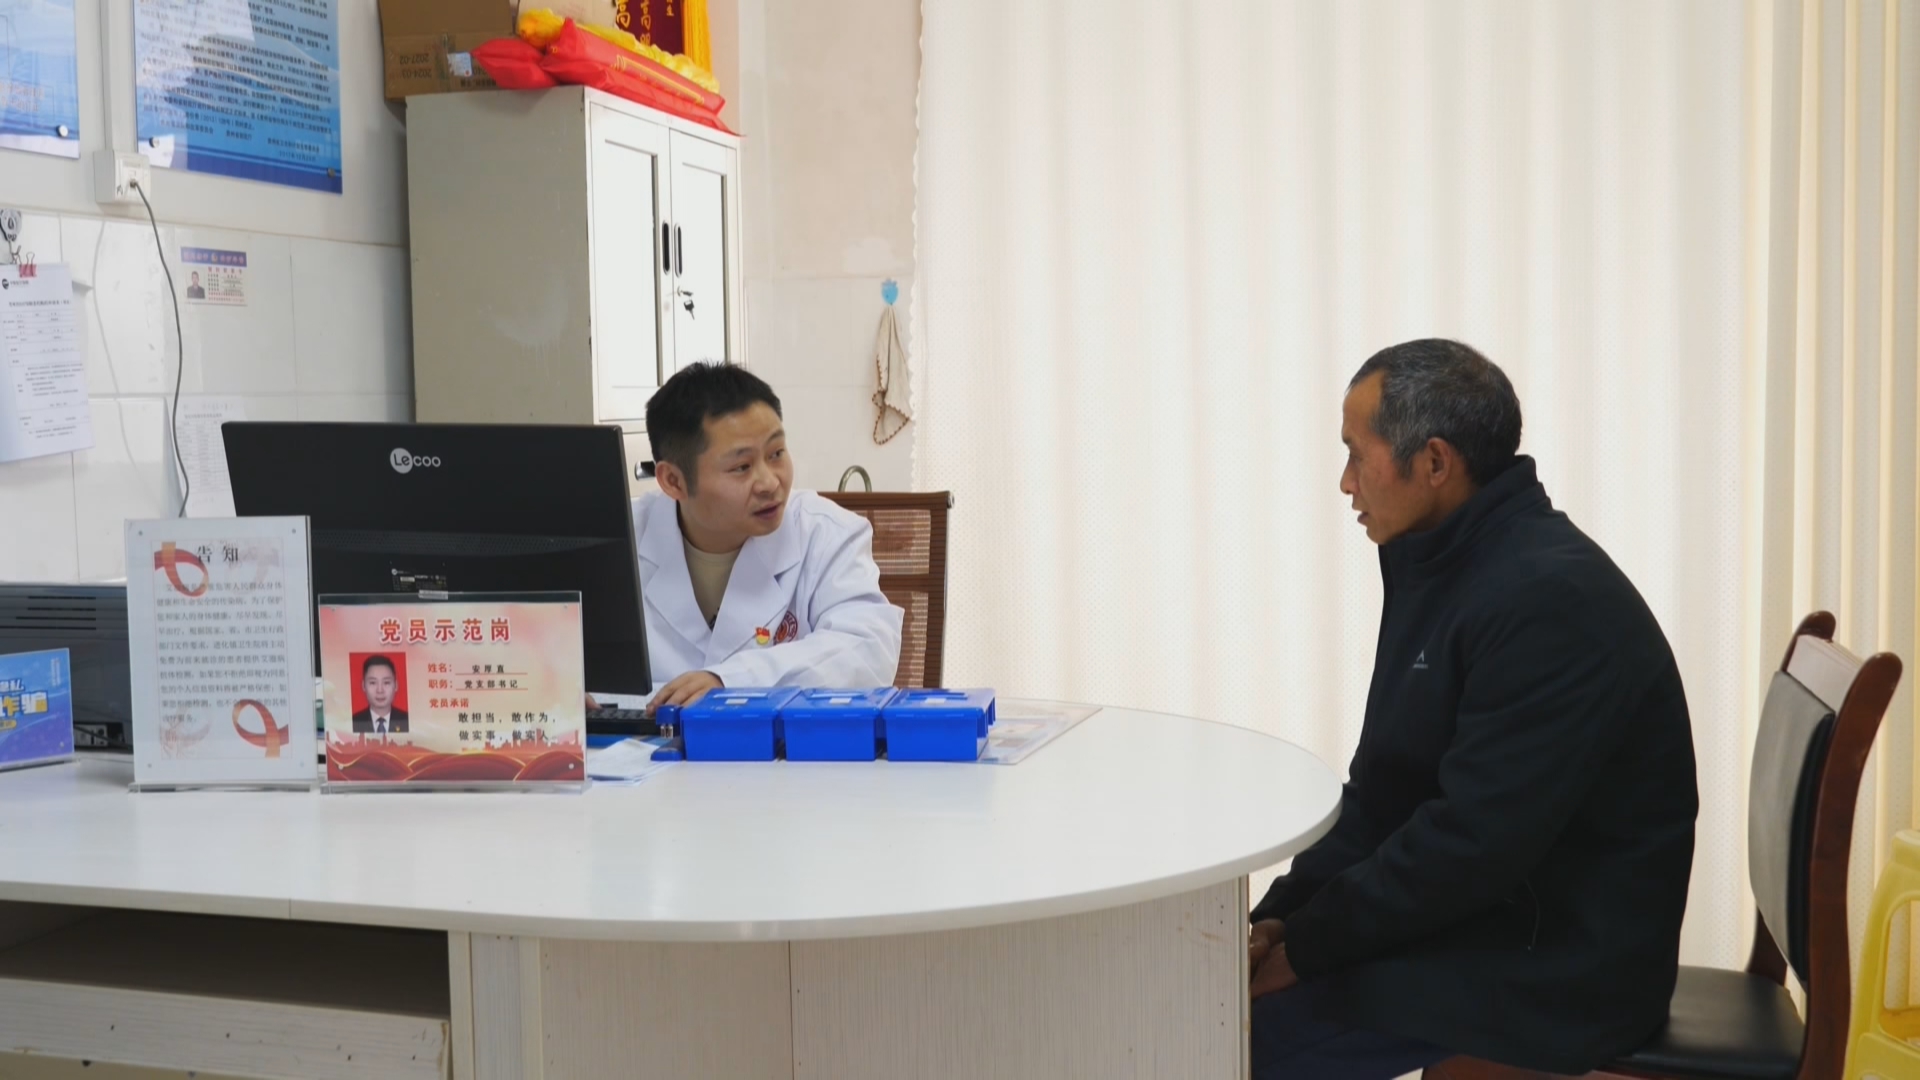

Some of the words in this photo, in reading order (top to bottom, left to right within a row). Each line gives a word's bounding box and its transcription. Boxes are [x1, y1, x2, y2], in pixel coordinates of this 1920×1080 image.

[390, 448, 441, 474] Lecoo
[197, 545, 240, 563] 告知
[380, 617, 509, 642] 党员示范岗
[464, 680, 518, 689] 党支部书记
[429, 698, 469, 708] 党员承诺
